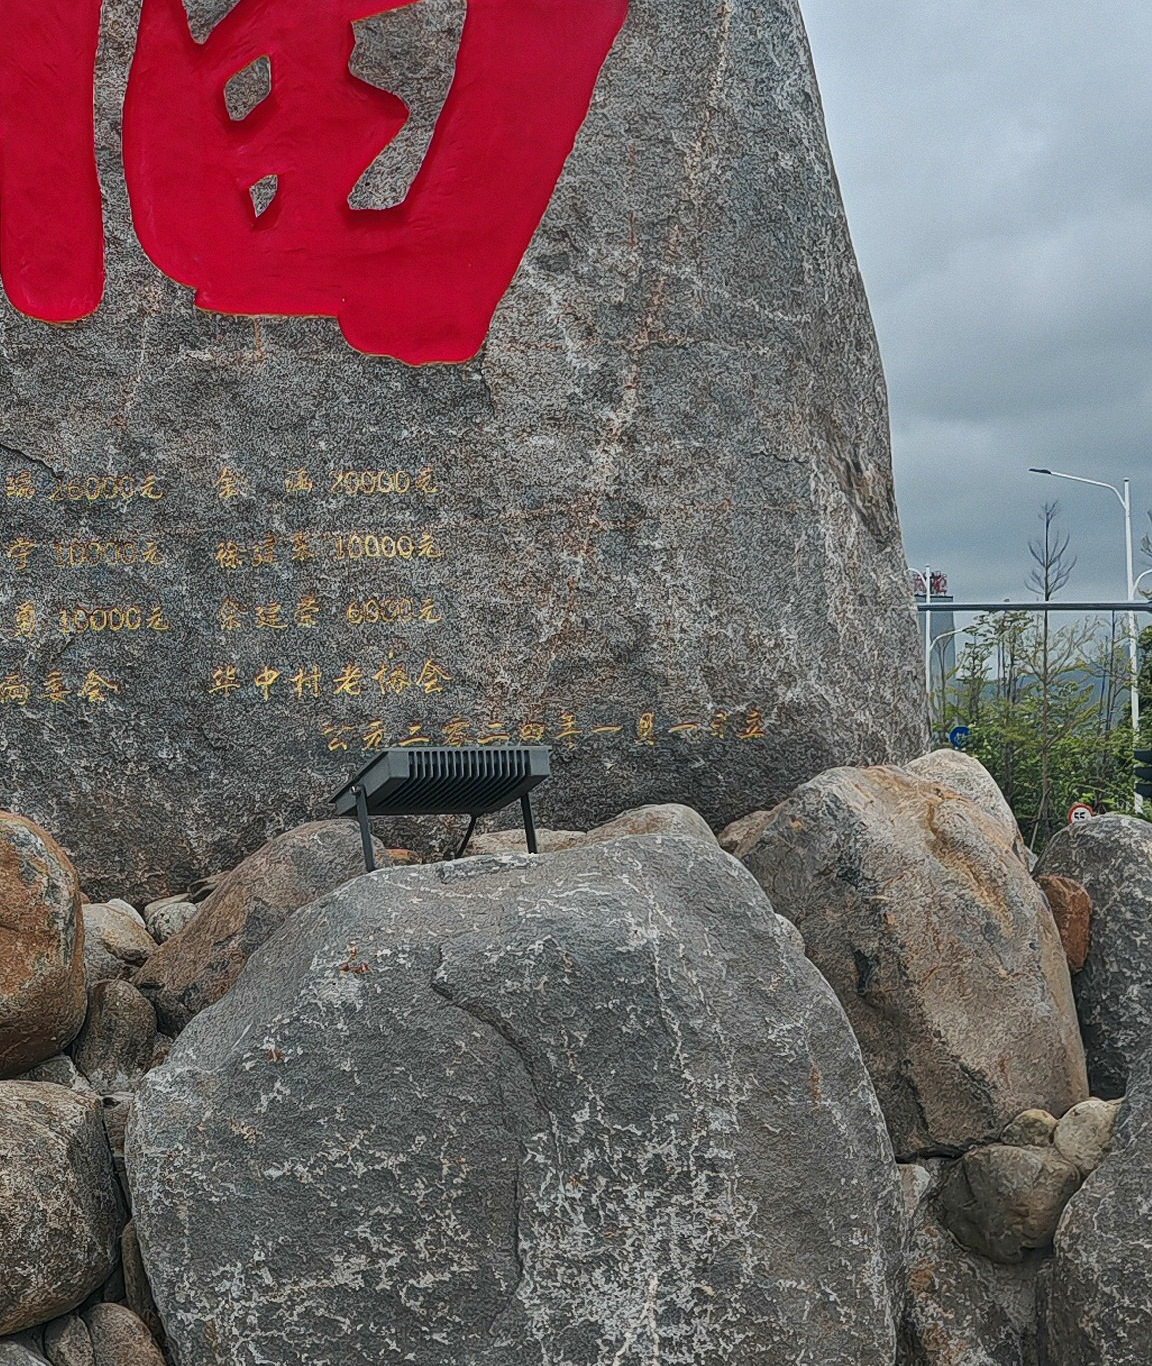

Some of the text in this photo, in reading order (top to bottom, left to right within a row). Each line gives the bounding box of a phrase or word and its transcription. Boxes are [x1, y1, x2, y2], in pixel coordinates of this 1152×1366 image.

[330, 467, 440, 494] 20000元
[52, 539, 165, 566] 10000元
[336, 533, 442, 559] 10000元
[60, 606, 170, 632] 10000元
[347, 598, 442, 624] 6000元
[208, 656, 452, 701] 华中村老协会
